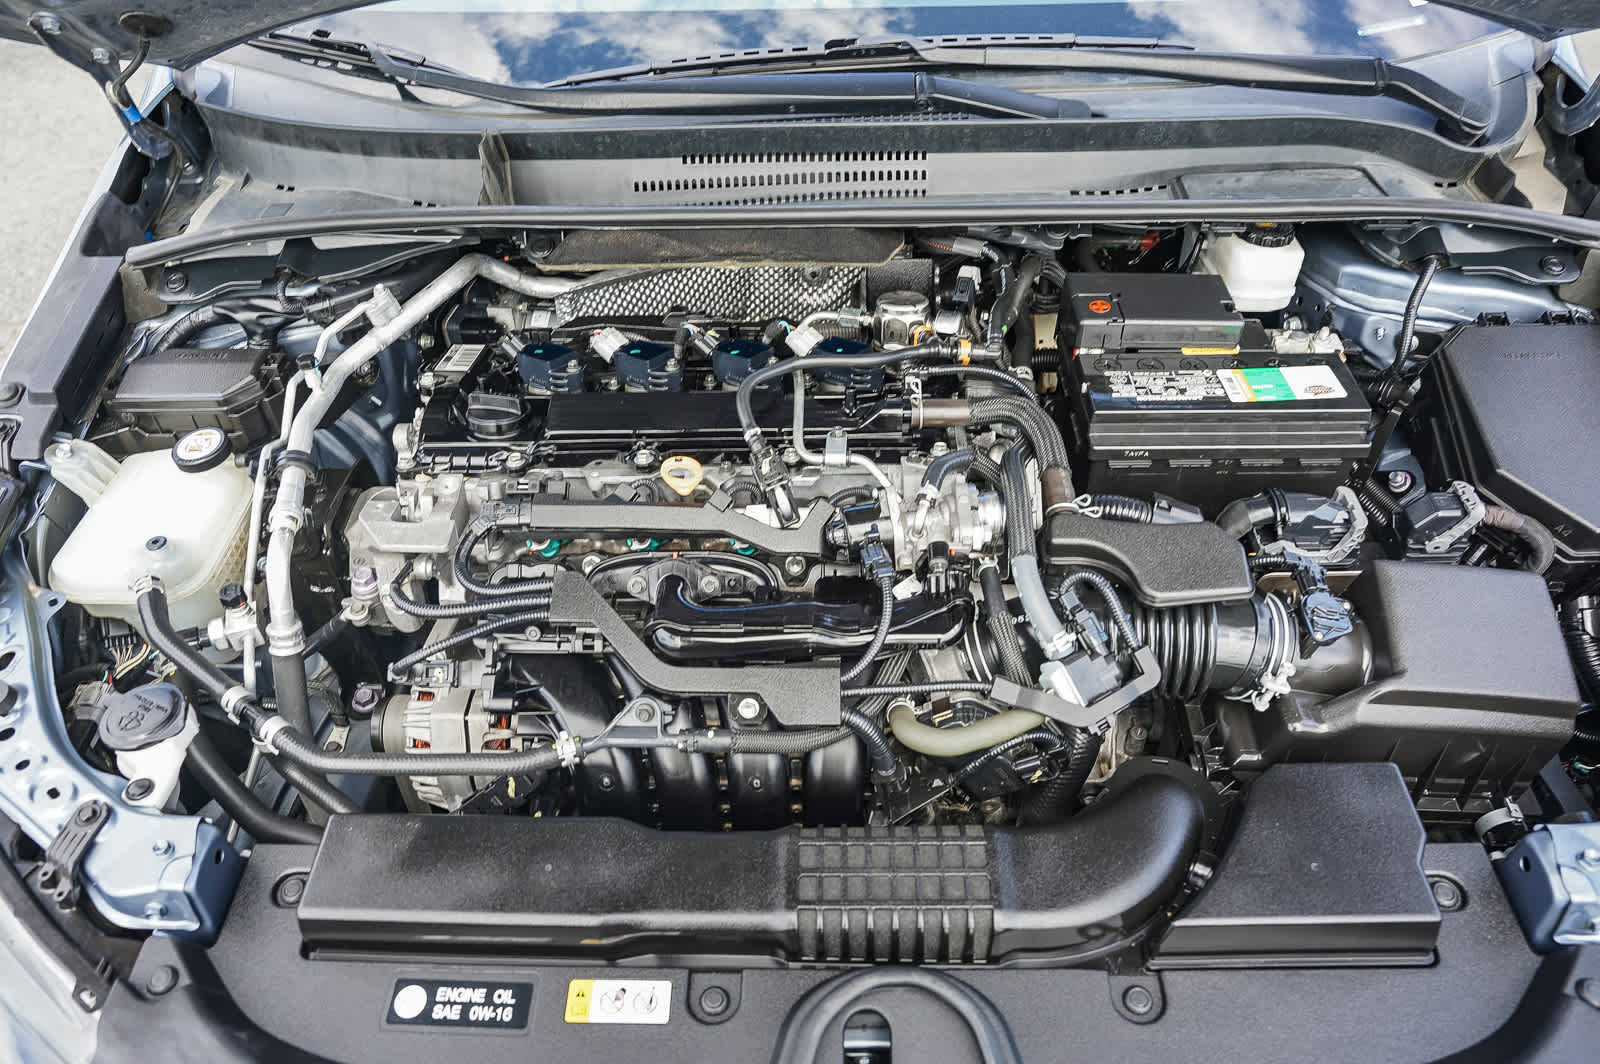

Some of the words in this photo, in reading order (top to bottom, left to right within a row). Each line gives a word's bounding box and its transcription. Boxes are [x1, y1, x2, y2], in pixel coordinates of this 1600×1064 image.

[436, 987, 486, 1003] ENGINE
[493, 989, 515, 1004] OIL
[432, 1004, 461, 1020] SAE
[469, 1005, 513, 1022] 0W-16
